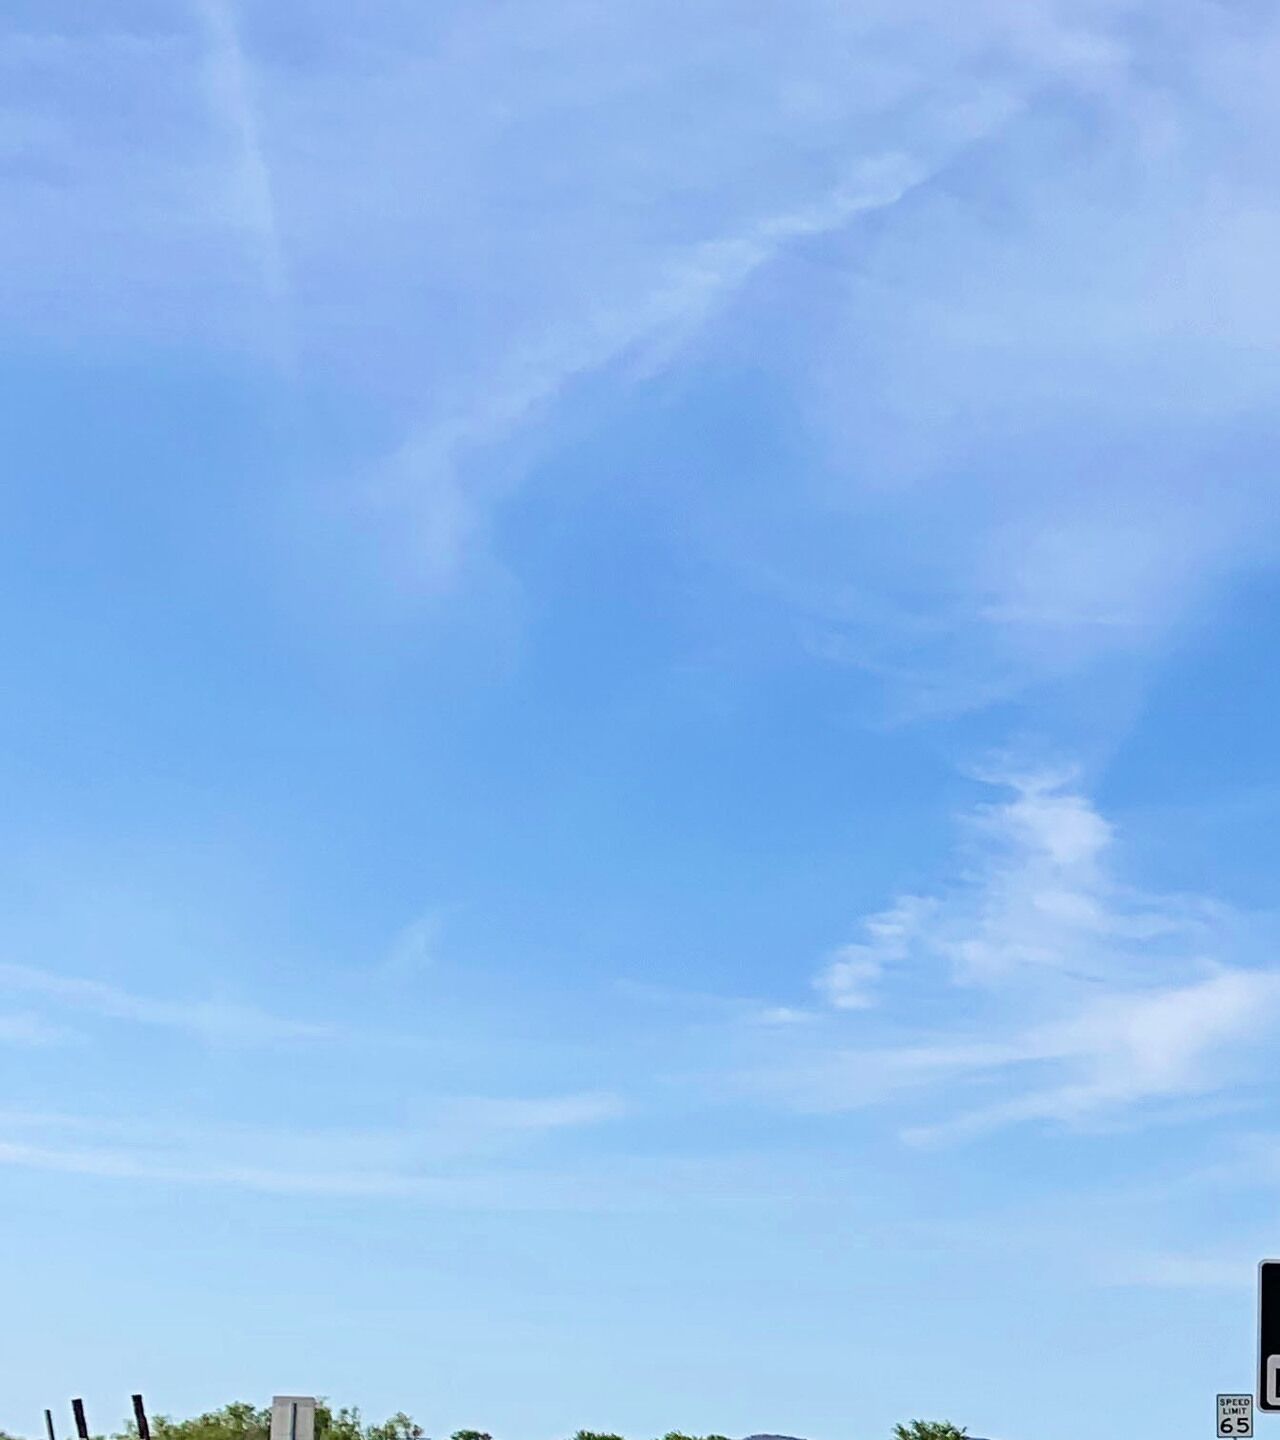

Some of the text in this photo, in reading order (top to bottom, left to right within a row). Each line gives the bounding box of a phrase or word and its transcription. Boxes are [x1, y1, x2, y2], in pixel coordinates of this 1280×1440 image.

[1219, 1398, 1250, 1406] SPEED
[1222, 1407, 1247, 1415] LIMIT
[1220, 1417, 1250, 1433] 65
